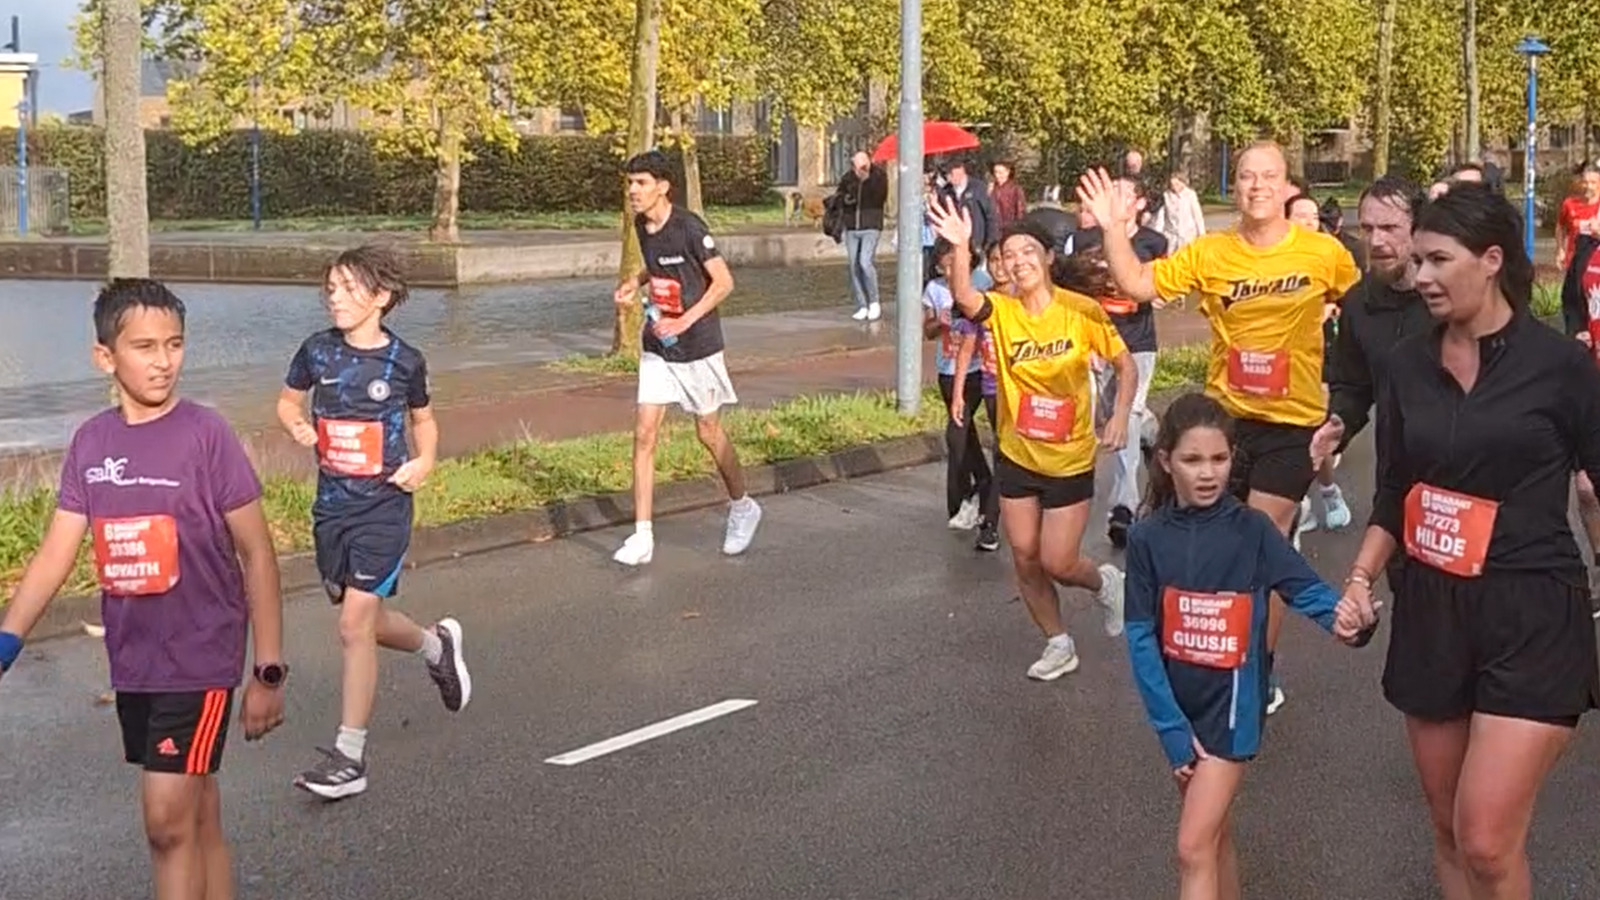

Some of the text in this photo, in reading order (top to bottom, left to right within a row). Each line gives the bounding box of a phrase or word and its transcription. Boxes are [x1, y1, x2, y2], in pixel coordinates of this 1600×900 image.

[1424, 511, 1461, 533] 37273
[1416, 525, 1467, 557] HILDE
[1182, 615, 1228, 632] 36996
[1173, 631, 1239, 652] GUUSJE
